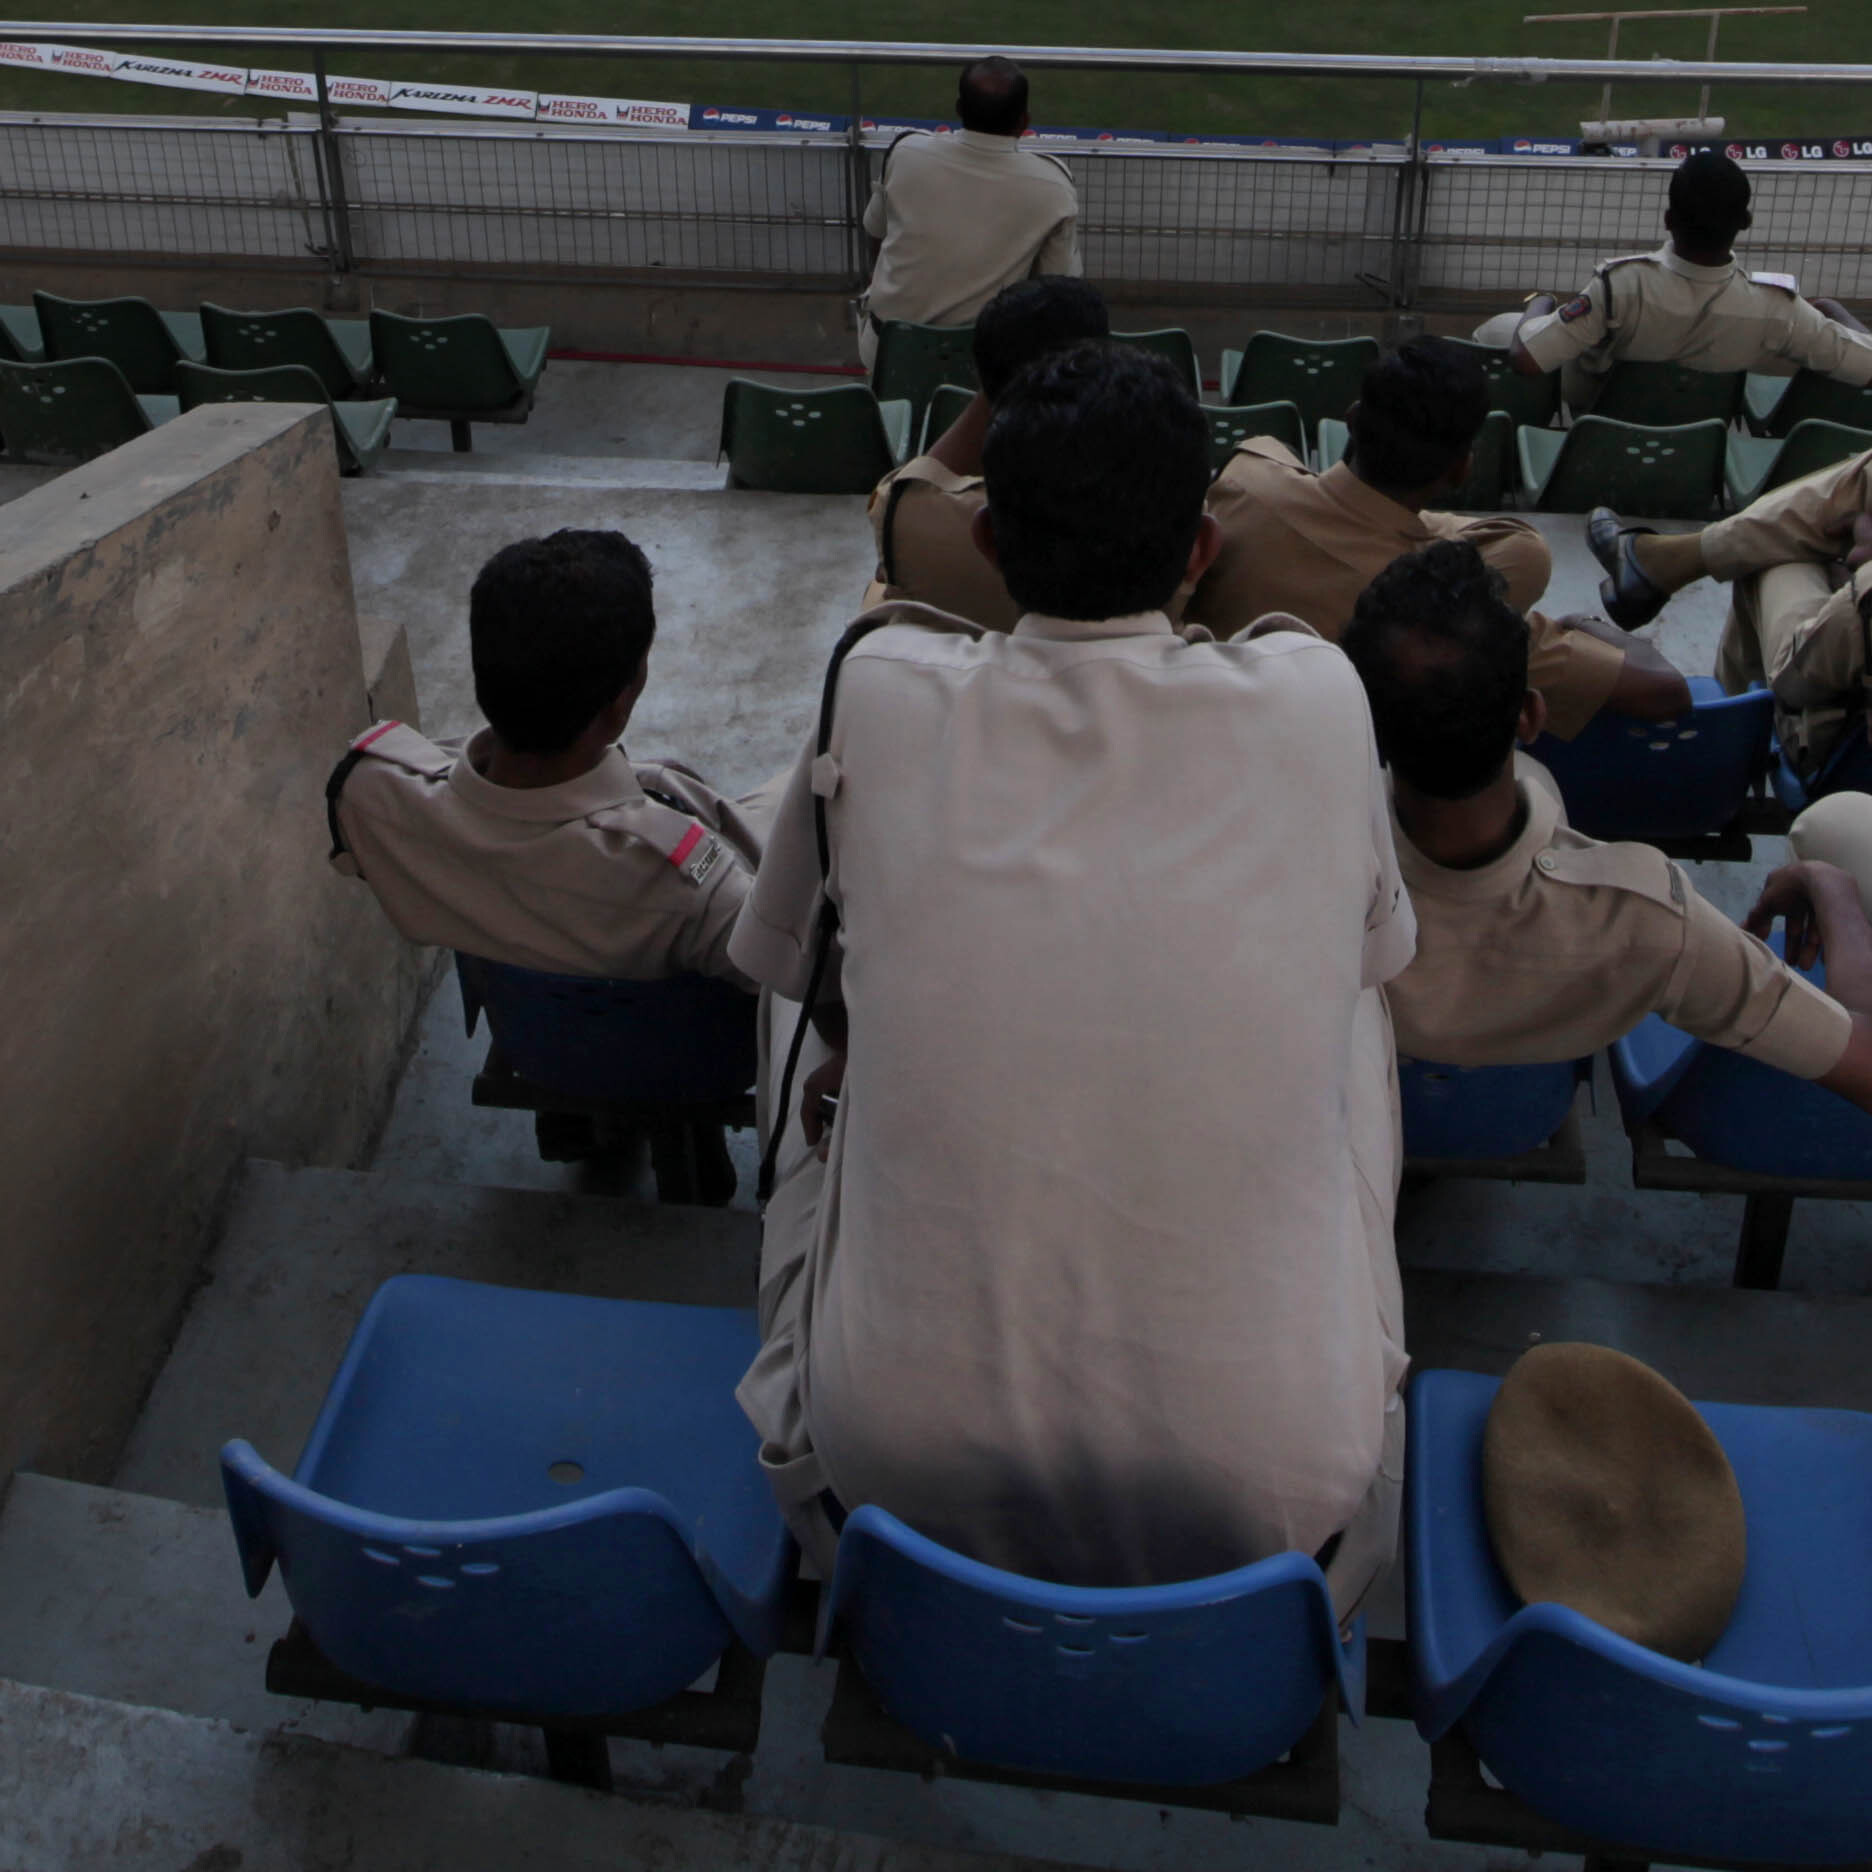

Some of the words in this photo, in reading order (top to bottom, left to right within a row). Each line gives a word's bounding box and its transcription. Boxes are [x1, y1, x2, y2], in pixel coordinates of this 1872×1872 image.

[63, 51, 105, 63] HERO
[63, 58, 112, 72] HONDA
[114, 60, 192, 77] KARIZMA
[197, 70, 243, 85] ZMR
[260, 74, 304, 86] HERO
[259, 83, 313, 95] HONDA
[334, 81, 378, 93] HERO
[333, 90, 389, 102] HONDA
[392, 87, 476, 103] KARIZMA
[482, 95, 533, 110] ZMR
[552, 100, 598, 111] HERO
[631, 105, 678, 116] HERO
[551, 109, 608, 120] HONDA
[631, 114, 689, 125] HONDA
[720, 113, 758, 124] PEPSI
[793, 119, 831, 131] PEPSI
[1532, 144, 1571, 154] PEPSI
[1746, 146, 1768, 158] LG
[1802, 146, 1823, 158] LG
